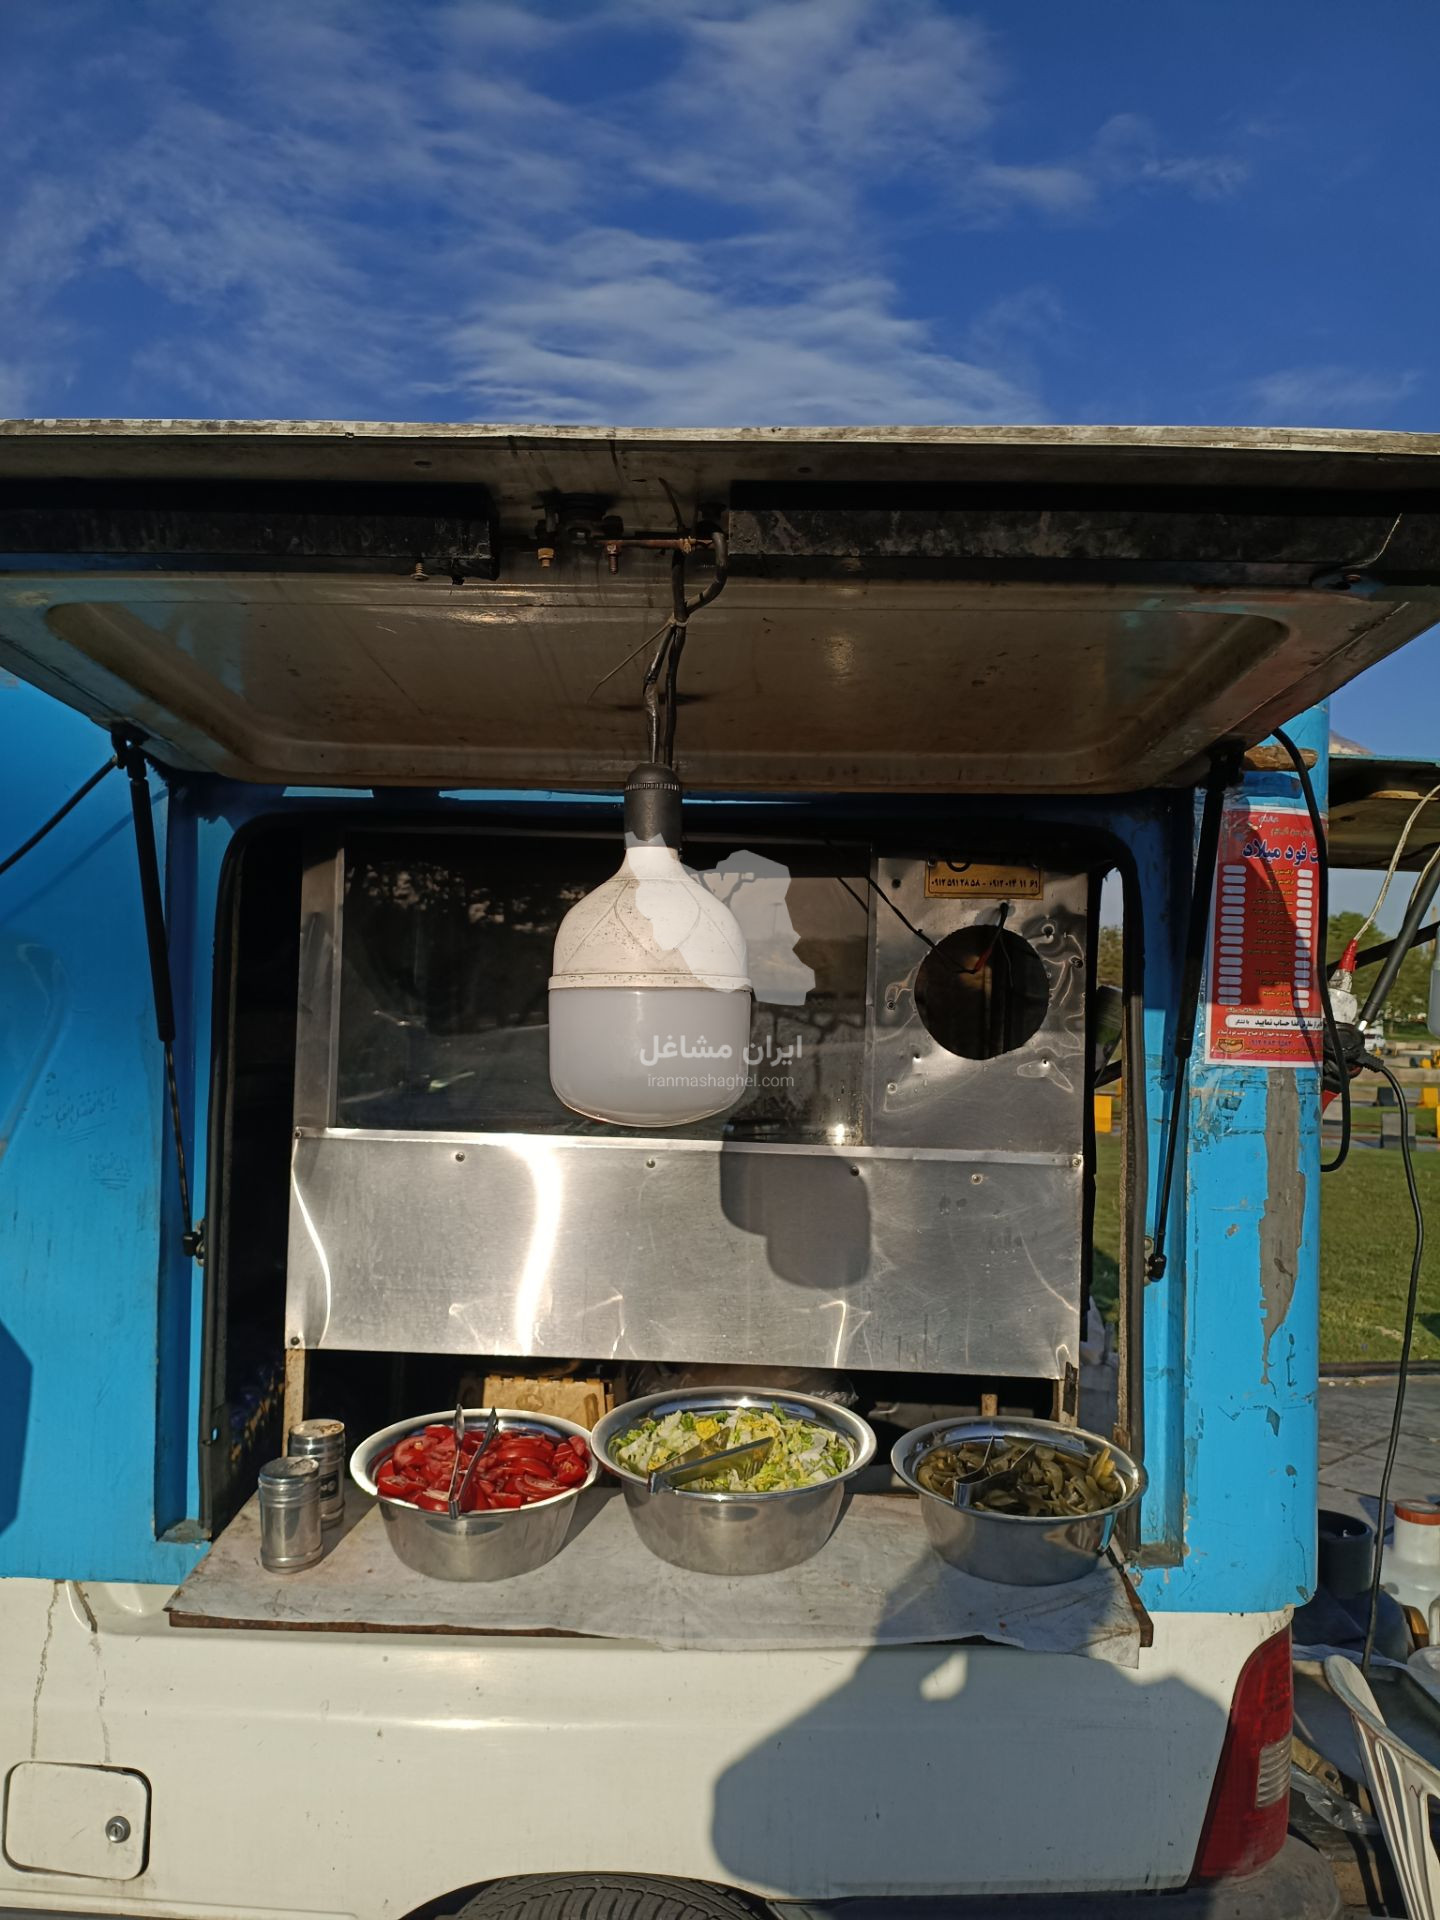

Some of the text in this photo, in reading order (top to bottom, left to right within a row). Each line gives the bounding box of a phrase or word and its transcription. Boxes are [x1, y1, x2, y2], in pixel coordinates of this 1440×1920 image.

[1242, 839, 1281, 865] میلاد
[1284, 841, 1307, 867] فود
[1255, 1018, 1272, 1027] نمایید
[1273, 1019, 1290, 1028] حساب
